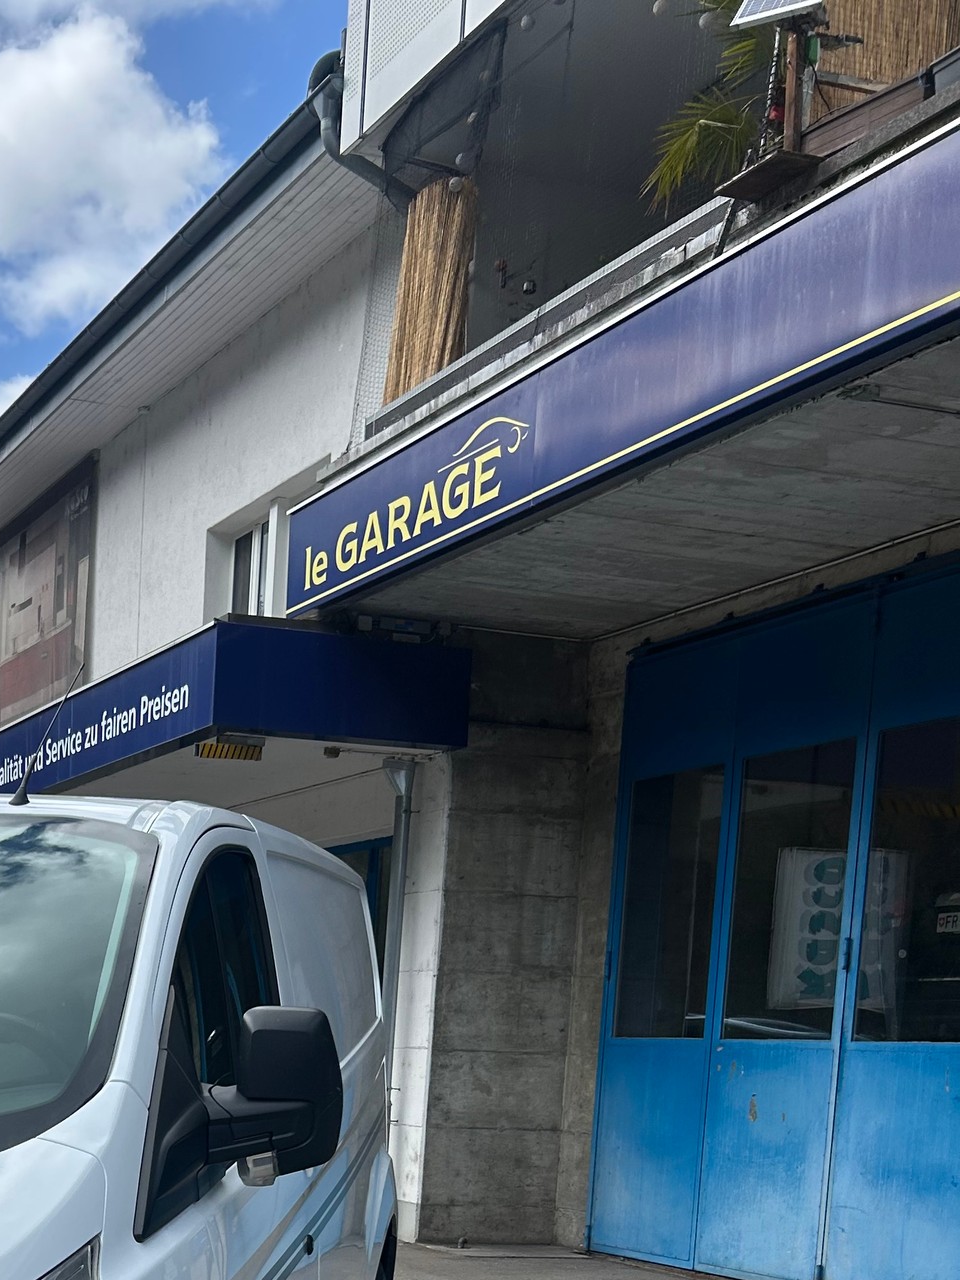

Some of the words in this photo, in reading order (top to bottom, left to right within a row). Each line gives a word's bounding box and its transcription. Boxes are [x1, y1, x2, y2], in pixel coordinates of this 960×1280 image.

[304, 546, 328, 591] le
[335, 445, 502, 572] GARAGE
[46, 728, 82, 766] Service
[85, 725, 98, 750] zu
[101, 706, 137, 742] fairen
[140, 683, 189, 727] Preisen
